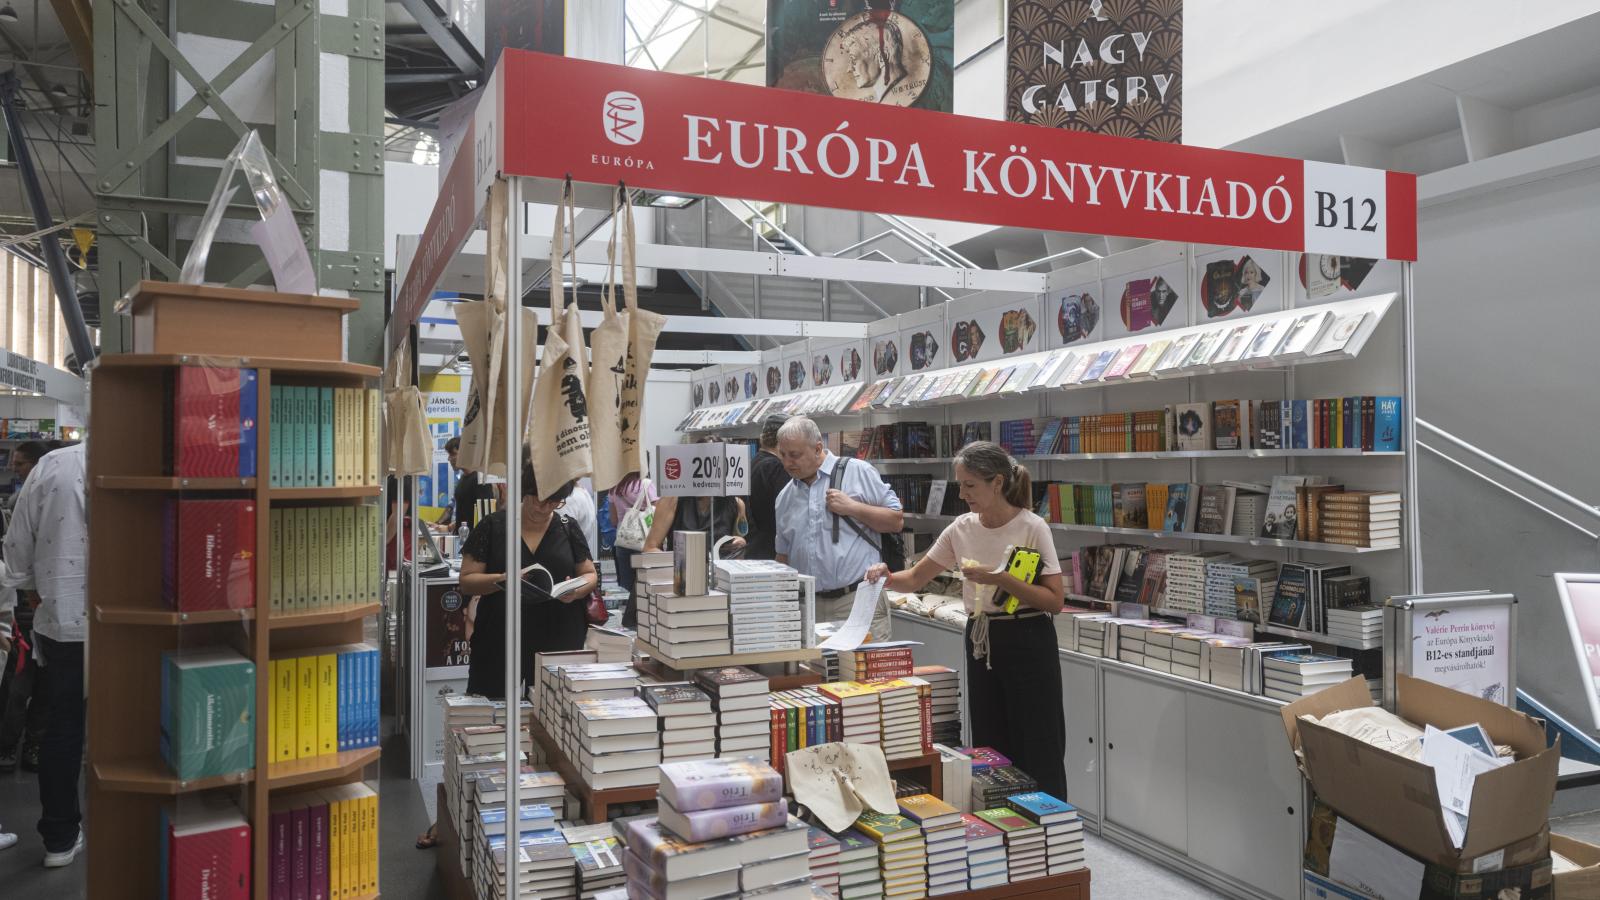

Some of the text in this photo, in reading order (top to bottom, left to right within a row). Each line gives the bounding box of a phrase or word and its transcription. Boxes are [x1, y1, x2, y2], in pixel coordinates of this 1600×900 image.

[1043, 30, 1153, 70] NAGY
[904, 79, 928, 91] TRUST
[1021, 73, 1174, 114] GATSBY
[476, 120, 493, 186] B12
[591, 154, 655, 171] EURÓPA
[682, 112, 1293, 224] EURÓPA KÖNYVKIADÓ
[1314, 190, 1379, 233] B12
[430, 396, 457, 405] JÁNOS:
[1381, 399, 1397, 411] HÁY
[426, 406, 460, 416] gerdilen
[557, 437, 578, 452] nem
[692, 456, 721, 479] 20%
[1424, 621, 1496, 635] Valérie Perrin könyvei
[1435, 636, 1458, 648] Európa
[1458, 633, 1494, 646] Könyvkiadó
[446, 654, 470, 665] A PO
[1426, 645, 1495, 661] B12-es standjánál
[1434, 661, 1486, 674] megvásárolhatók!
[722, 786, 748, 797] Trio
[733, 812, 759, 824] Trio
